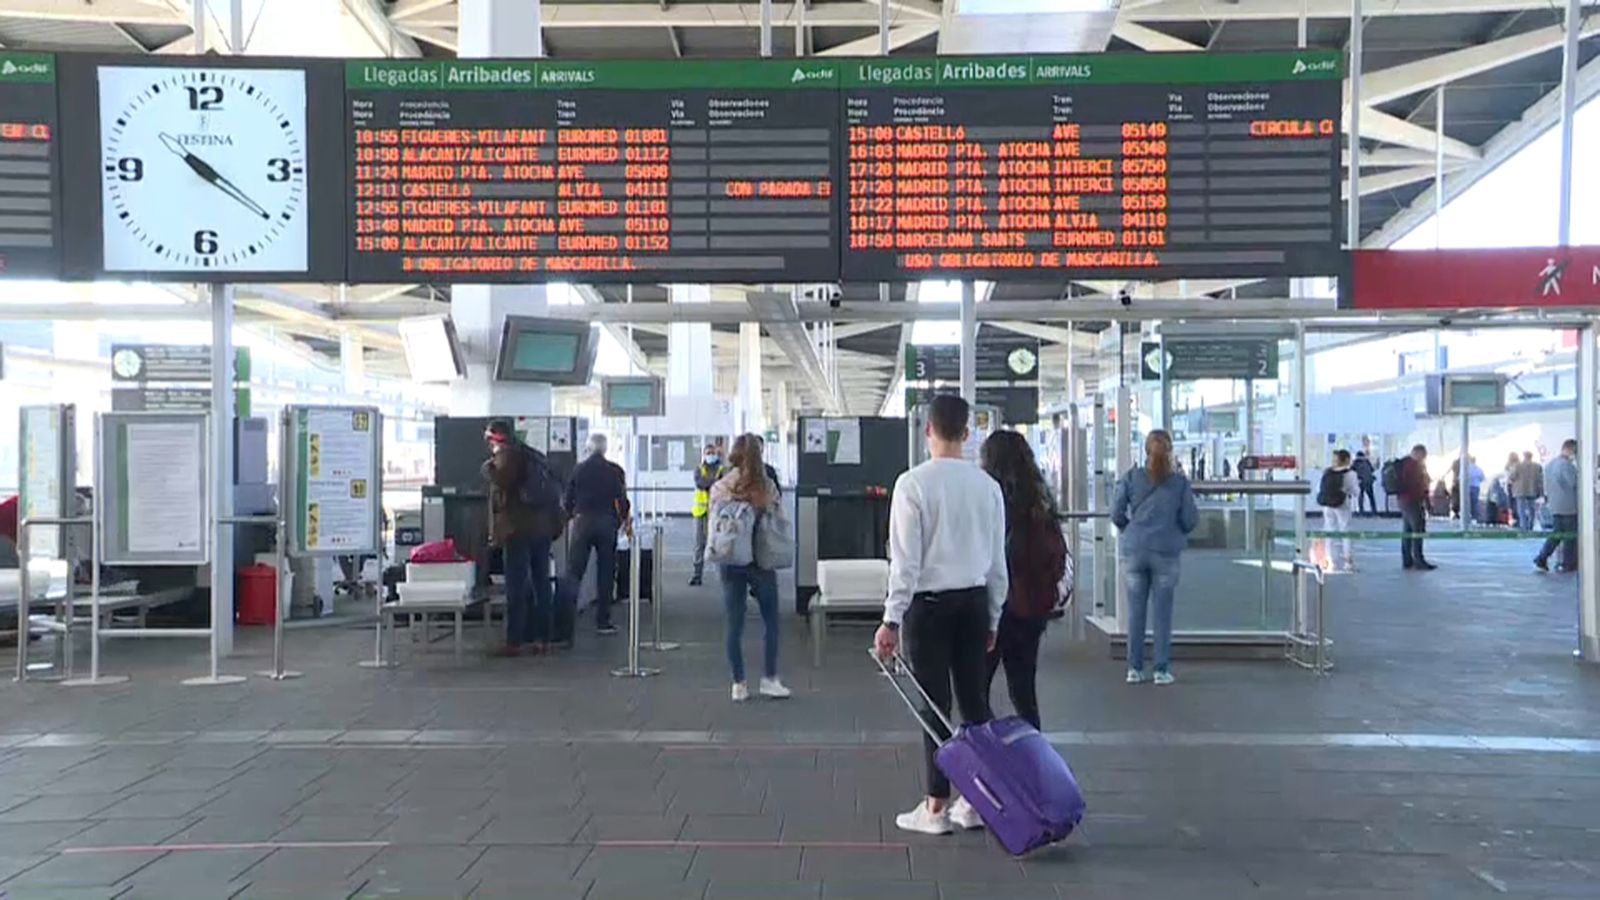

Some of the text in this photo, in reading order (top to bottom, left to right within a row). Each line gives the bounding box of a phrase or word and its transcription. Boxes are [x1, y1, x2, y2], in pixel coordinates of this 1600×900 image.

[363, 67, 438, 86] Llegadas
[448, 66, 531, 83] Arribades
[541, 70, 595, 83] ARRIVALS
[858, 65, 933, 83] Llegadas
[943, 63, 1027, 79] Arribades
[1036, 65, 1092, 78] ARRIVALS
[184, 86, 225, 111] 12
[355, 130, 400, 143] 10:55
[557, 130, 619, 143] EUROMED
[1054, 124, 1080, 139] AVE
[1250, 120, 1313, 135] CIRCULA
[176, 134, 234, 146] FESTINA
[402, 148, 539, 161] ALACANT/ALICANTE
[557, 148, 619, 161] EUROMED
[849, 144, 893, 158] 16:03
[896, 144, 949, 157] MADRID
[956, 143, 988, 156] PTA.
[998, 143, 1050, 156] ATOCHA
[1054, 142, 1080, 156] AVE
[118, 157, 144, 182] 9
[266, 158, 291, 182] 3
[355, 165, 400, 179] 11:24
[402, 165, 454, 179] MADRID
[461, 165, 493, 179] PTA.
[503, 165, 555, 179] ATOCHA
[557, 165, 585, 179] AVE
[849, 162, 893, 176] 17:20
[896, 162, 949, 175] MADRID
[956, 161, 988, 174] PTA.
[998, 161, 1050, 174] ATOCHA
[1054, 160, 1112, 174] INTERCI
[355, 183, 400, 196] 12:11
[557, 183, 602, 196] ALVIA
[625, 183, 667, 196] 04111
[725, 182, 753, 196] CON
[759, 182, 811, 196] PARADA
[849, 180, 893, 194] 17:20
[896, 180, 949, 193] MADRID
[956, 179, 988, 192] PTA.
[998, 179, 1050, 192] ATOCHA
[1054, 178, 1112, 192] INTERCI
[355, 201, 400, 214] 12:55
[557, 201, 619, 214] EUROMED
[849, 198, 893, 212] 17:22
[896, 198, 949, 211] MADRID
[956, 197, 988, 210] PTA.
[998, 197, 1050, 210] ATOCHA
[1054, 196, 1080, 210] AVE
[402, 219, 454, 232] MADRID
[461, 219, 493, 232] PTA.
[503, 219, 555, 232] ATOCHA
[557, 219, 585, 232] AVE
[896, 216, 949, 229] MADRID
[956, 215, 988, 228] PTA.
[998, 215, 1050, 228] ATOCHA
[1054, 214, 1097, 228] ALVIA
[193, 230, 218, 255] 6
[402, 236, 539, 250] ALACANT/ALICANTE
[557, 236, 619, 250] EUROMED
[896, 233, 973, 247] BARCELONA
[981, 233, 1026, 246] SANTS
[1054, 232, 1115, 246] EUROMED
[419, 257, 513, 270] OBLIGATORIO
[520, 257, 538, 270] DE
[905, 252, 1159, 267] USO OBLIGATORIO DE MASCARILLA.
[916, 362, 926, 377] 3
[1258, 360, 1268, 376] 2
